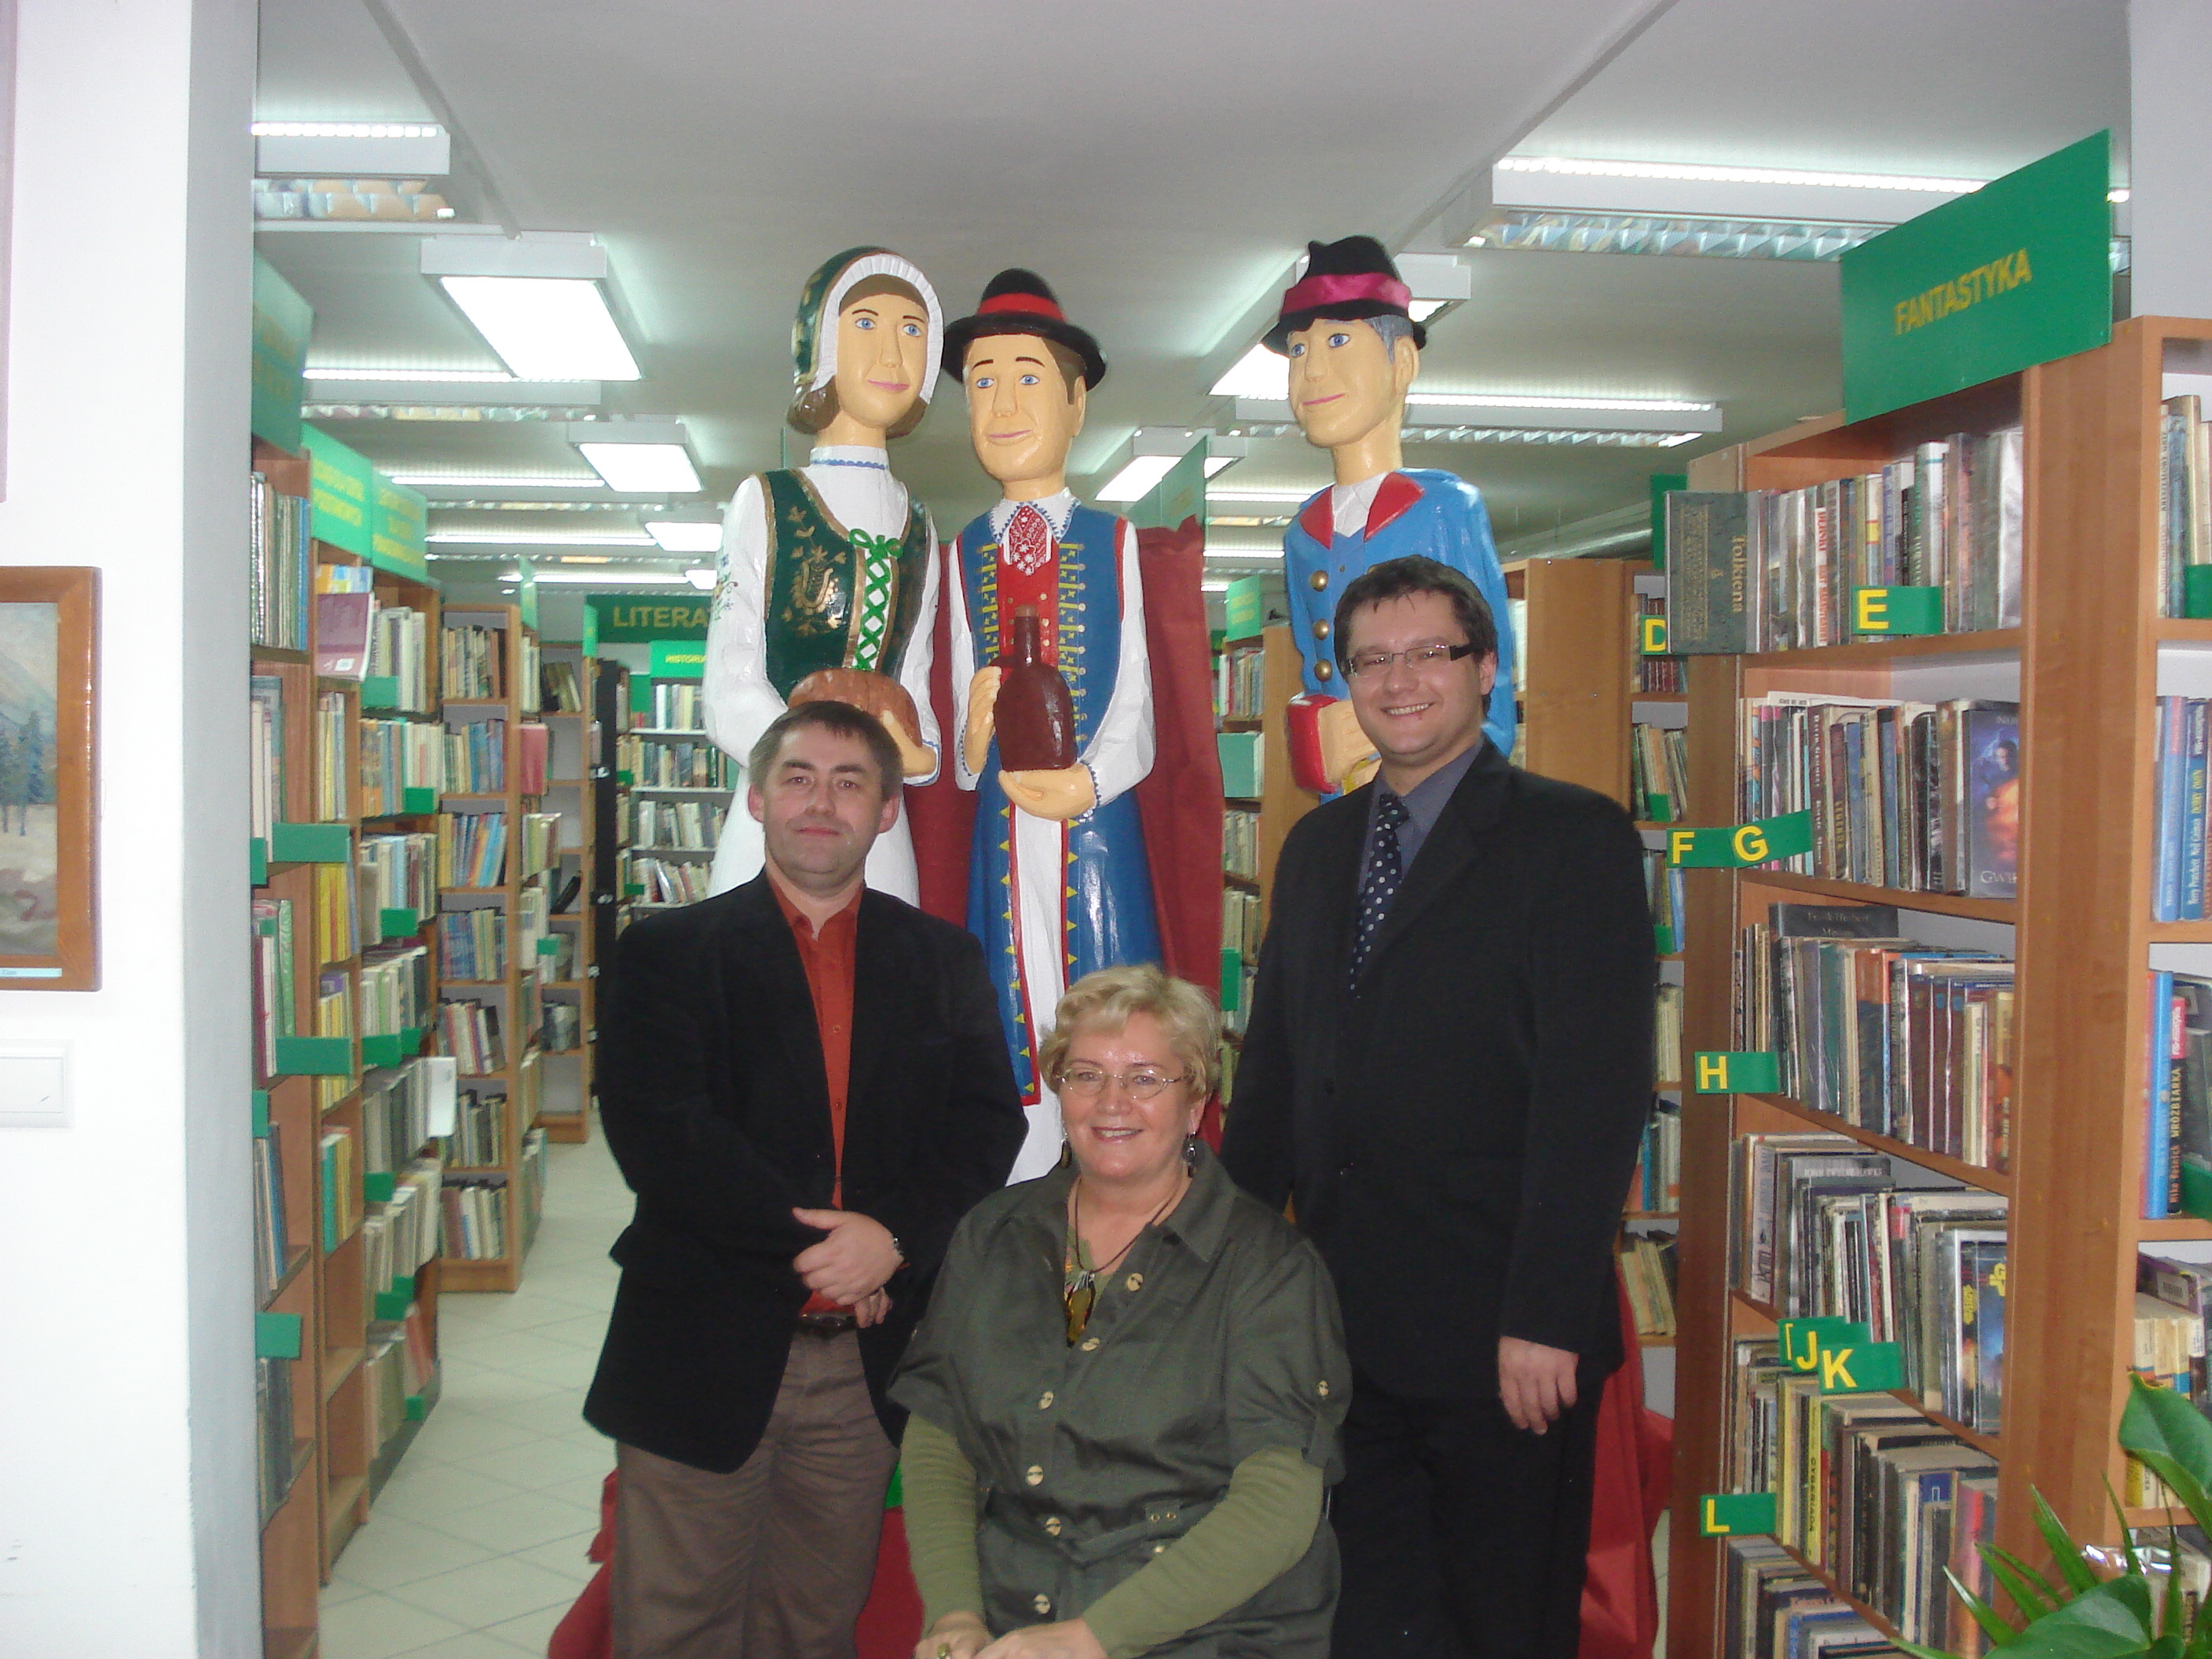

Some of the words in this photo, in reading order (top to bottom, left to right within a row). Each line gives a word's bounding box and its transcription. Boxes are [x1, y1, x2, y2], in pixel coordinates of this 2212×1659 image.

[1894, 247, 2033, 335] FANTASTYKA
[613, 606, 710, 628] LITERA
[1859, 589, 1888, 629] E
[1645, 618, 1666, 651] D
[1672, 831, 1695, 863] F
[1734, 826, 1768, 862] G
[1700, 1056, 1727, 1090] H
[1796, 1331, 1818, 1370] J
[1822, 1349, 1858, 1389] K
[1707, 1499, 1730, 1533] L
